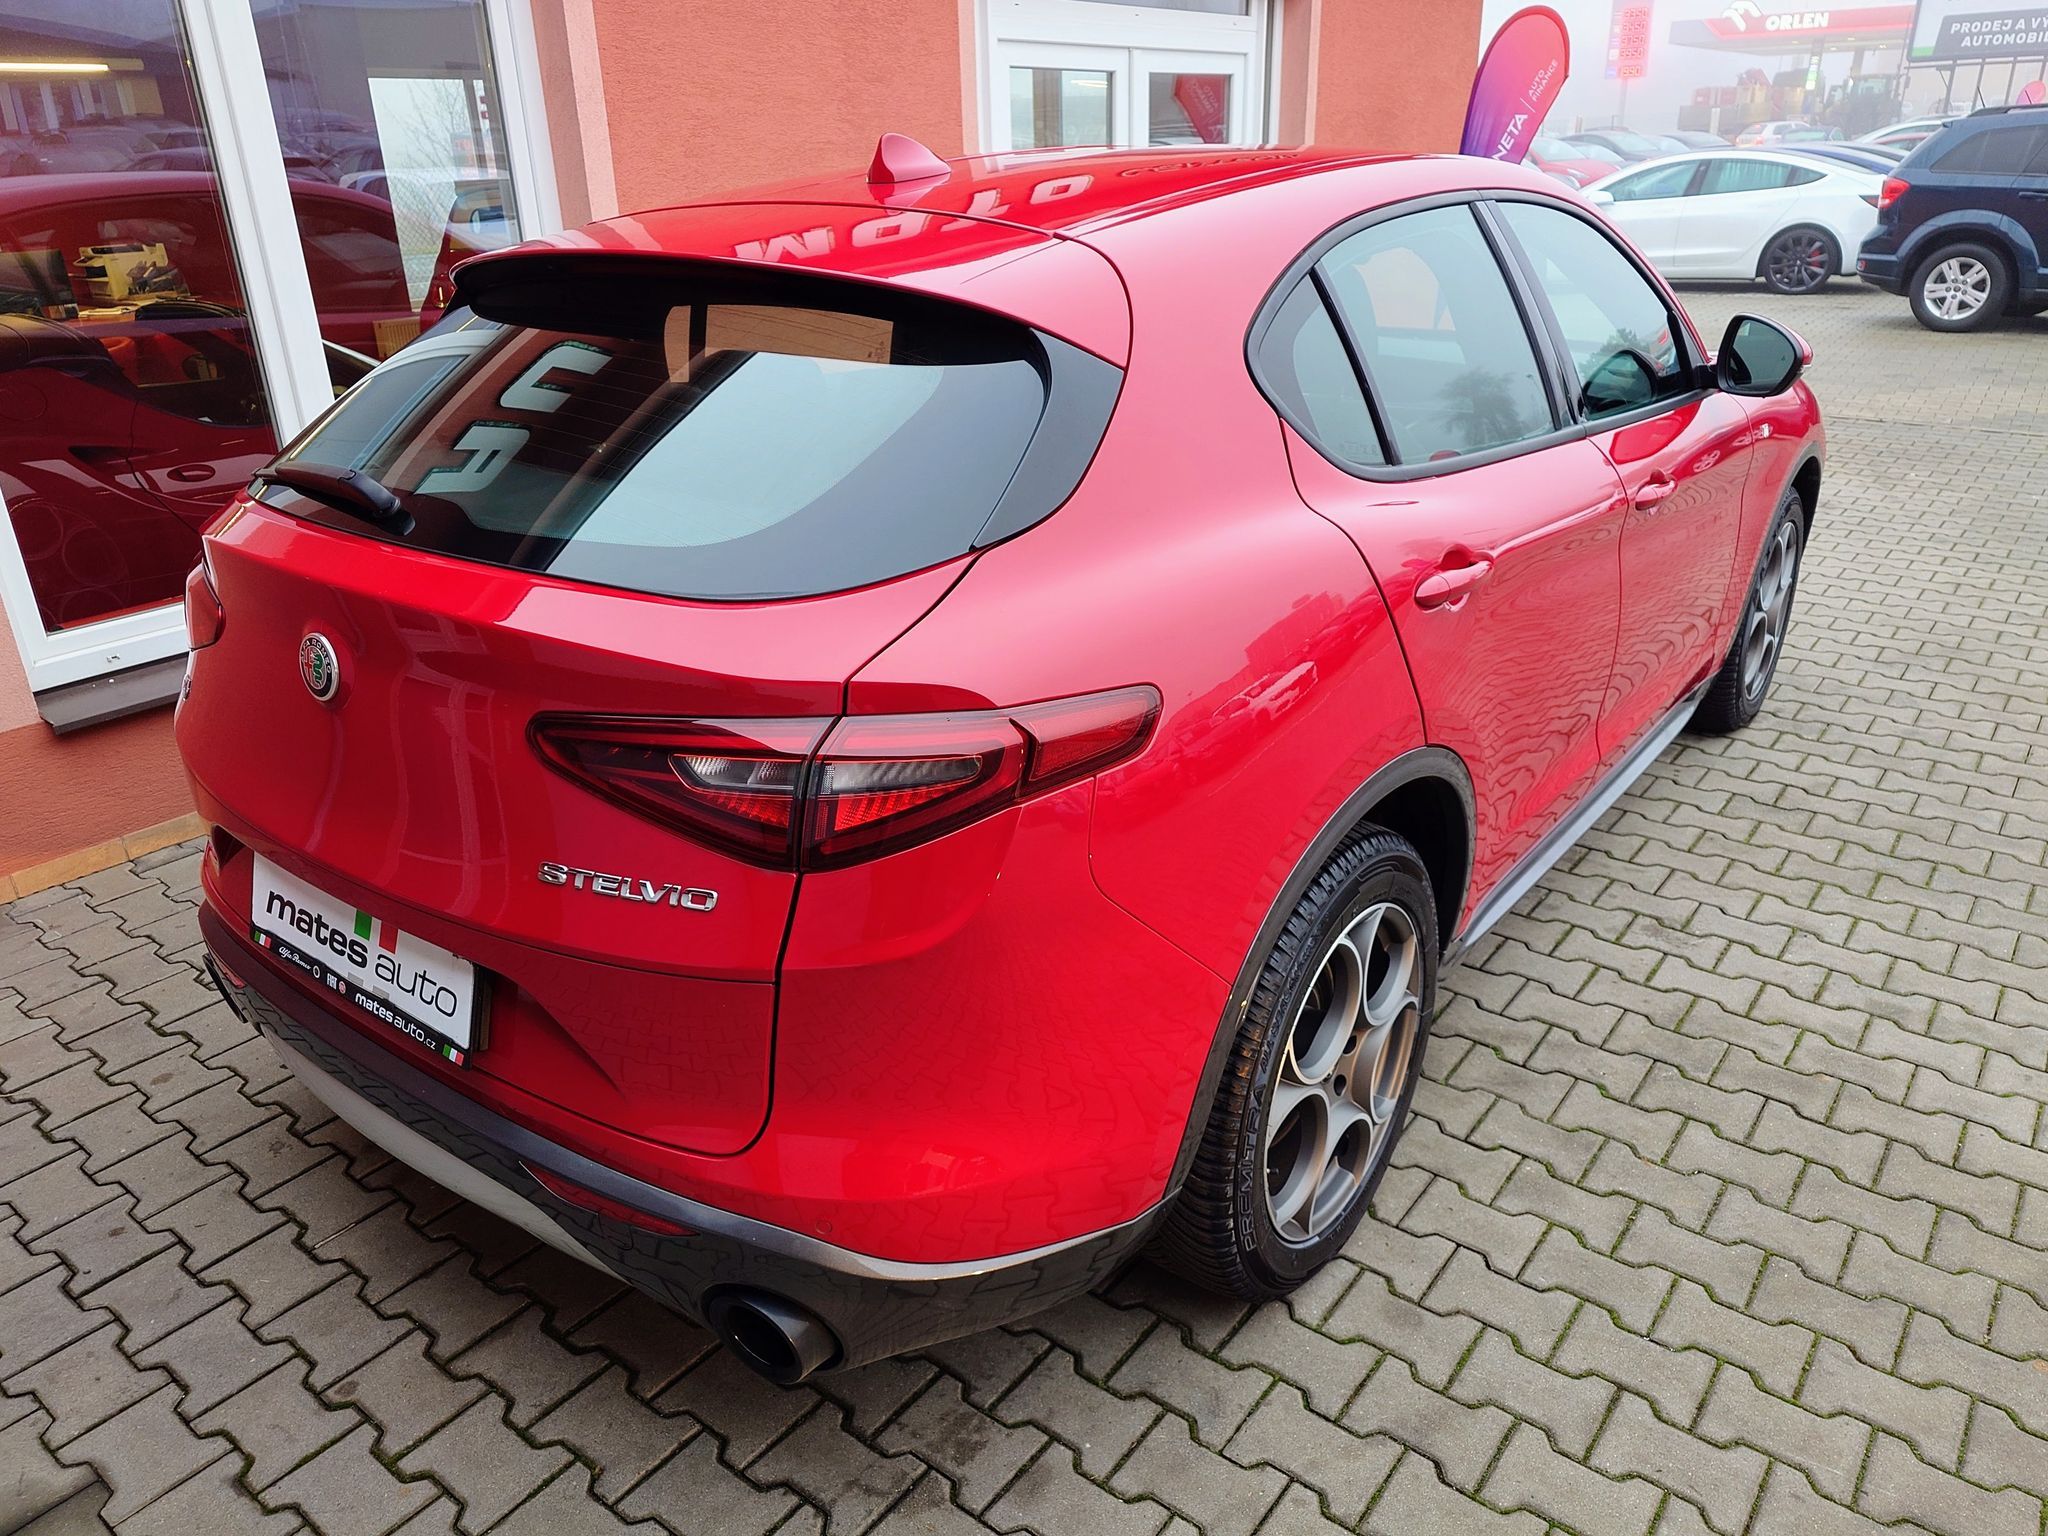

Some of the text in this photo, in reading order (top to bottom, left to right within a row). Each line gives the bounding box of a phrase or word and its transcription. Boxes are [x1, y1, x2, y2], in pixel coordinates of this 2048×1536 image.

[1765, 12, 1829, 31] ORLEN
[1950, 19, 2012, 34] PRODEJ
[2015, 18, 2025, 30] A
[1528, 69, 1545, 97] AUTO
[1531, 59, 1558, 102] FINANCE
[538, 861, 719, 912] STELVIO
[265, 889, 458, 1018] mates auto
